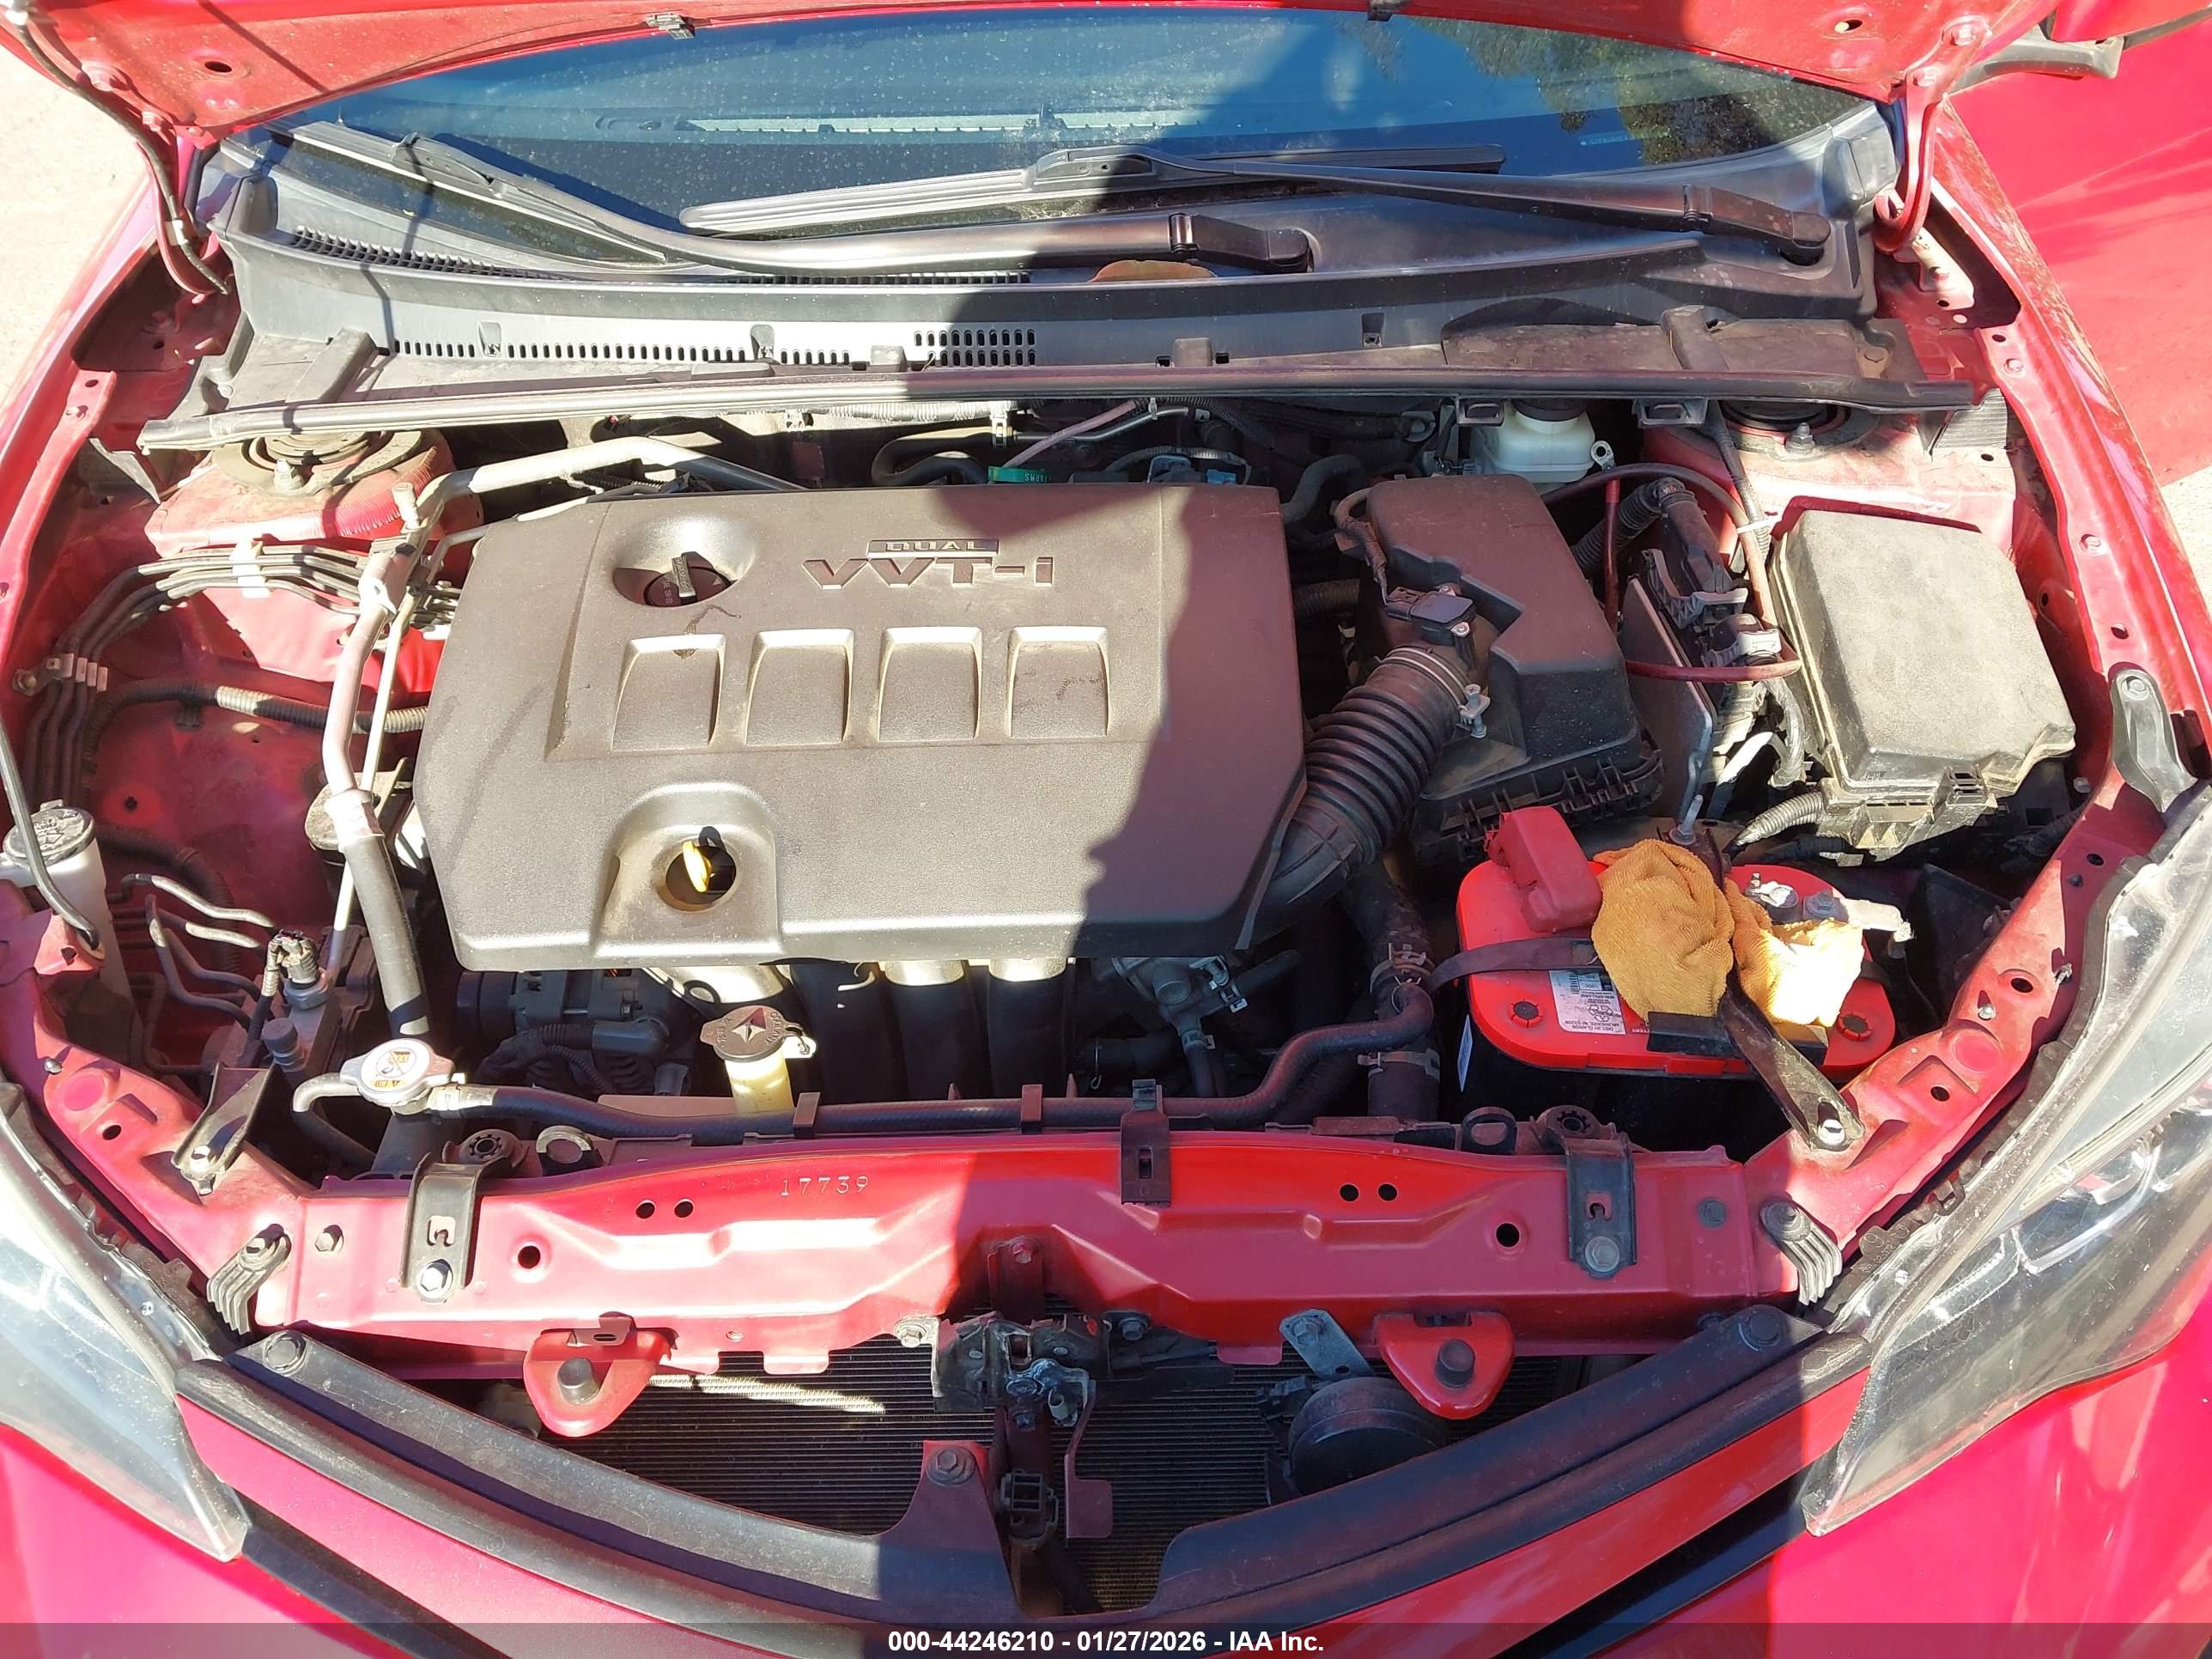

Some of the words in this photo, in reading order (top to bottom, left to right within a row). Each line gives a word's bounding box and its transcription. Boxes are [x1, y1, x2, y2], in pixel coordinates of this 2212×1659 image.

[885, 541, 986, 550] DUAL
[800, 556, 1054, 589] VVT-i
[781, 1176, 869, 1196] 17739
